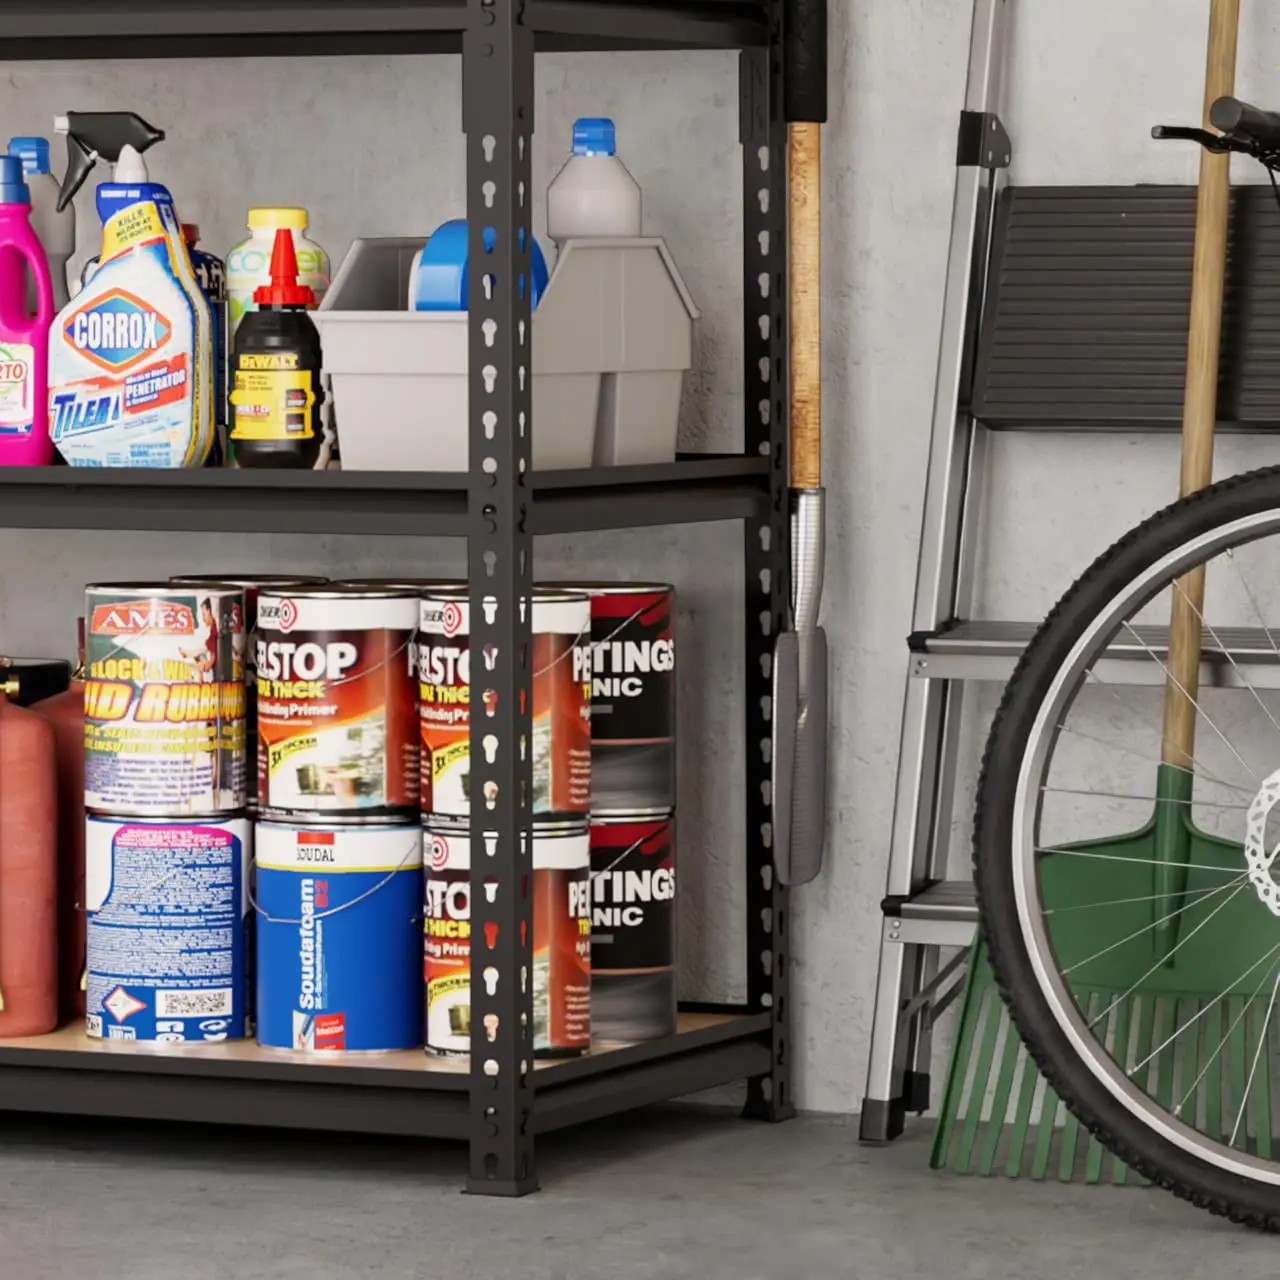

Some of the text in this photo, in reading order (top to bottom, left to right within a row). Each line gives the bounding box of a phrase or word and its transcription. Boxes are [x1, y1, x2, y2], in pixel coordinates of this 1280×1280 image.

[226, 250, 323, 272] coer
[74, 312, 158, 350] CORROX
[126, 369, 186, 399] PENETRATOR
[101, 607, 188, 631] AMES
[591, 639, 675, 673] TINGS
[592, 677, 643, 698] NIC
[289, 703, 339, 717] Primer
[591, 869, 675, 904] TINGS
[591, 907, 644, 927] NIC
[299, 878, 315, 1011] Soudafoam
